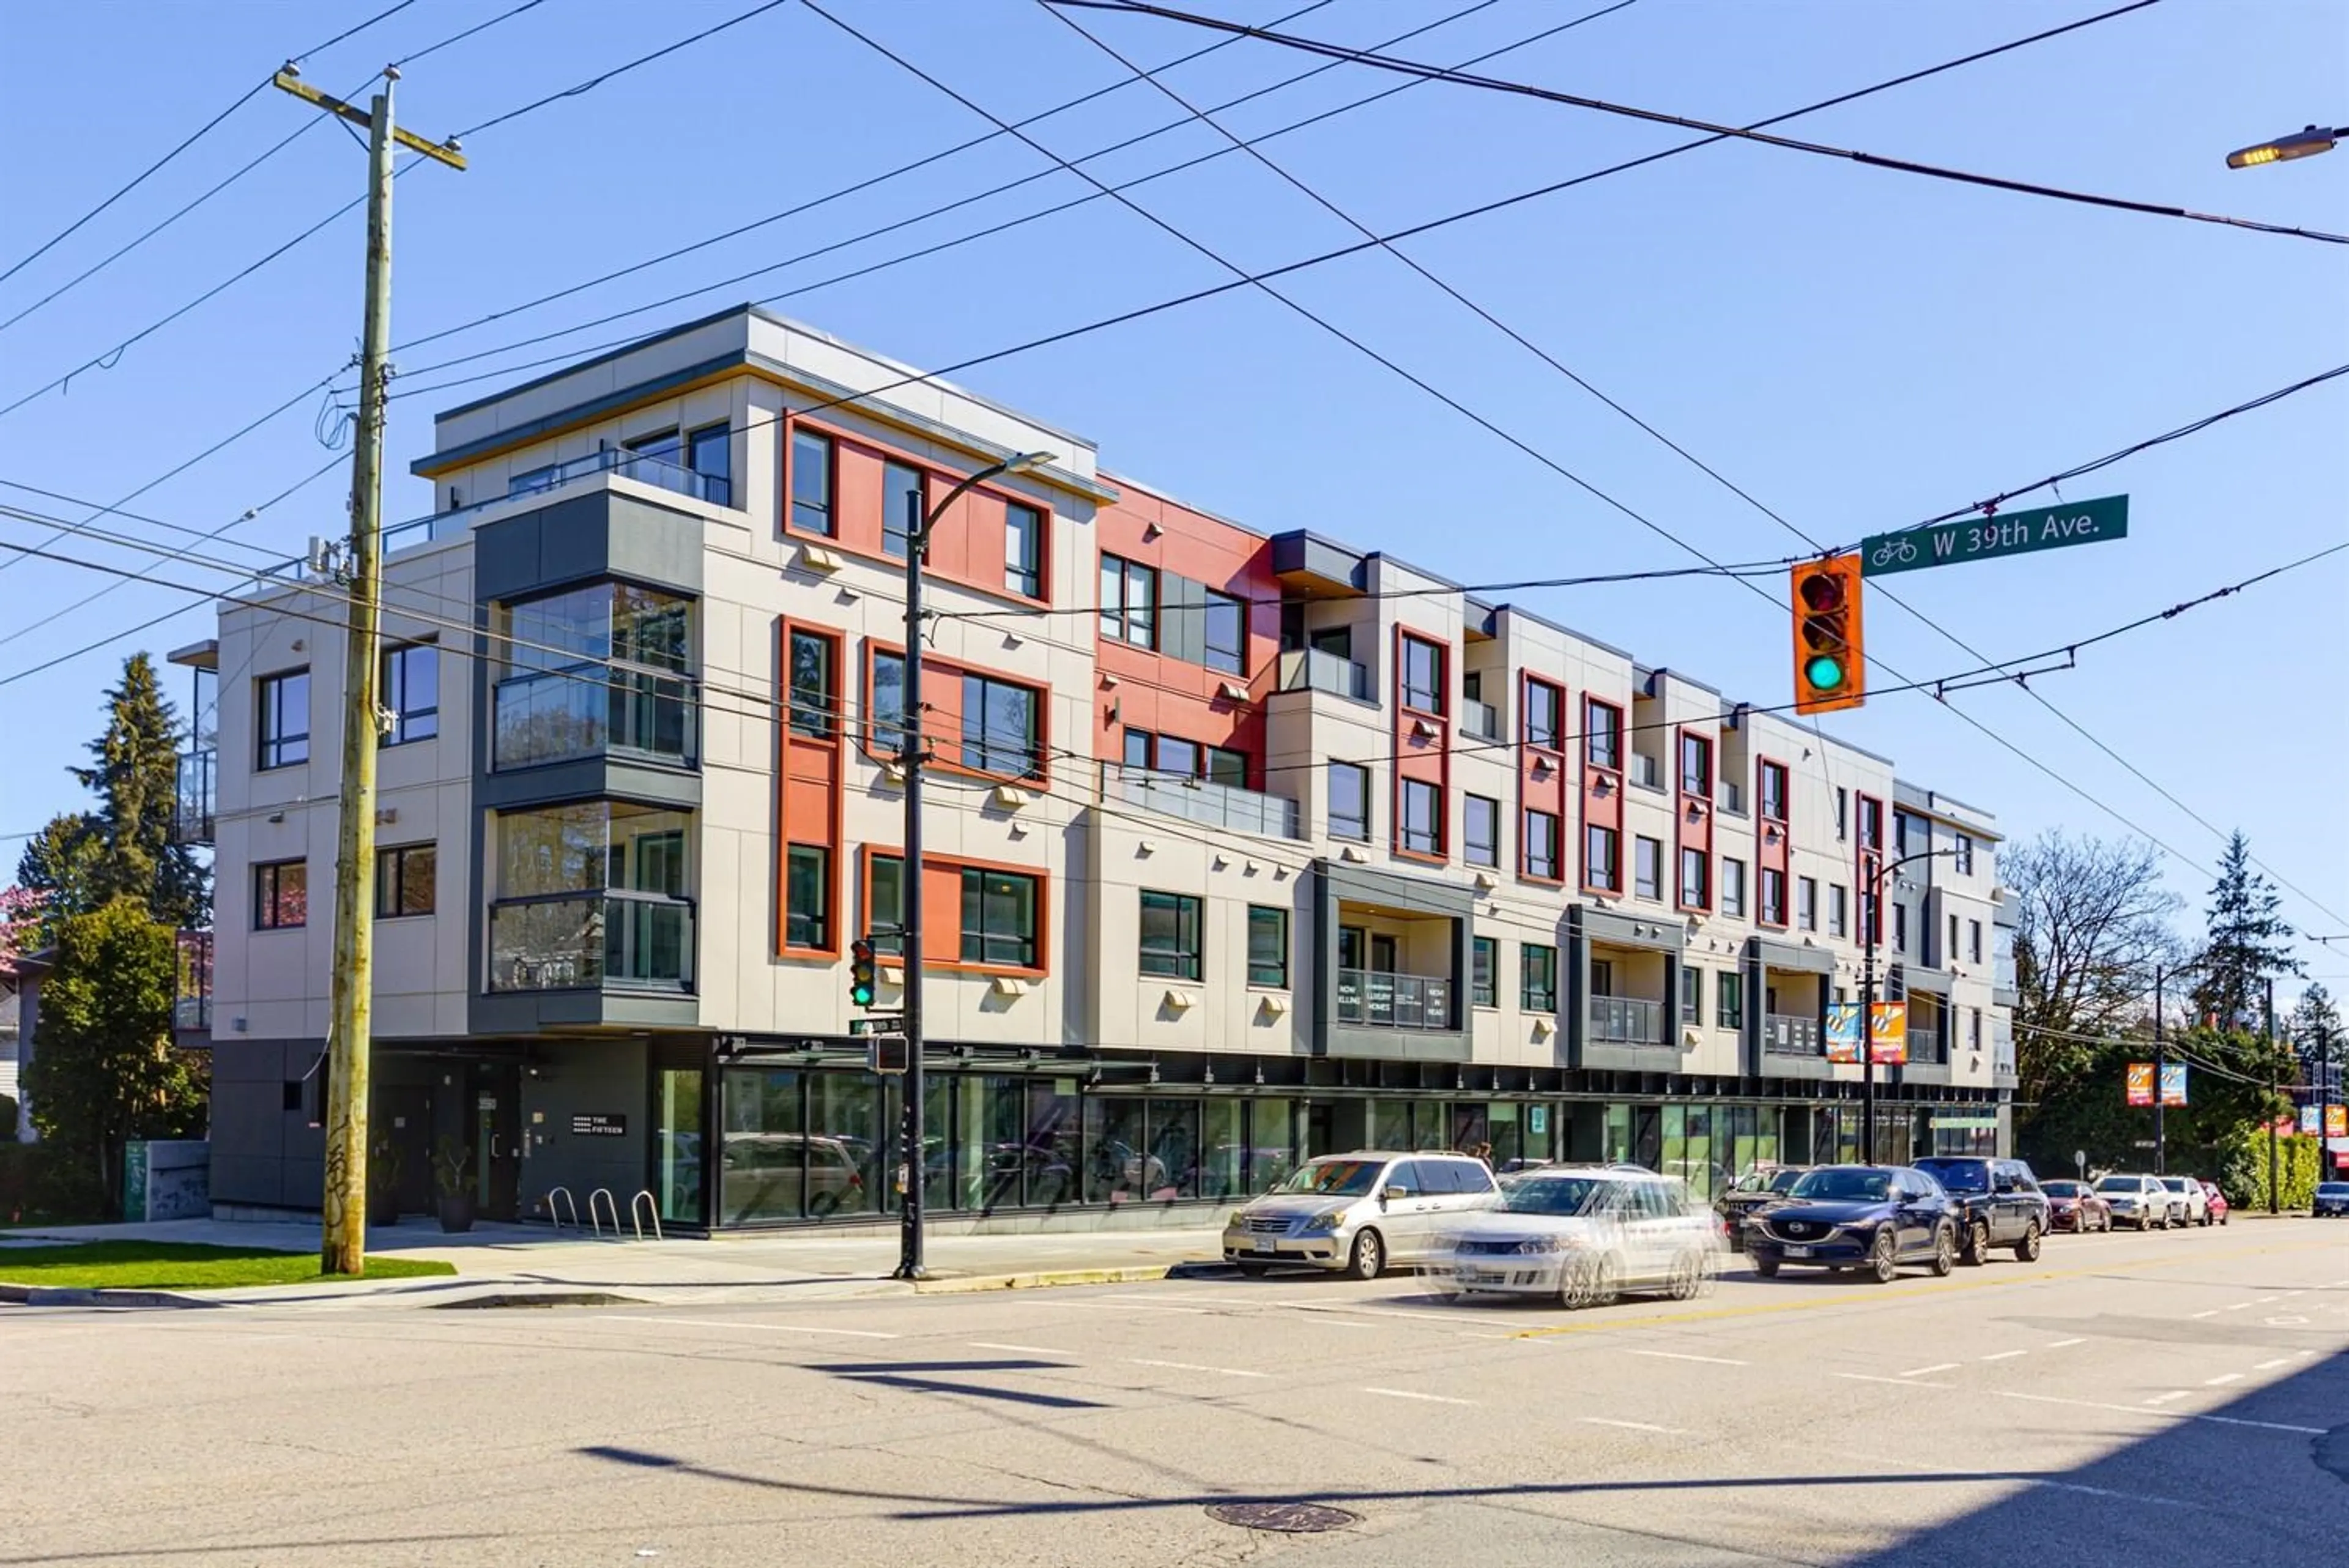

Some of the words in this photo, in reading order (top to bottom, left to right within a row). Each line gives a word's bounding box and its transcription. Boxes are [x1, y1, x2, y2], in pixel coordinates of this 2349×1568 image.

[1934, 530, 1956, 557] W
[1967, 519, 2028, 552] 39th
[2041, 515, 2099, 540] Ave.
[1338, 995, 1360, 1005] ELLING
